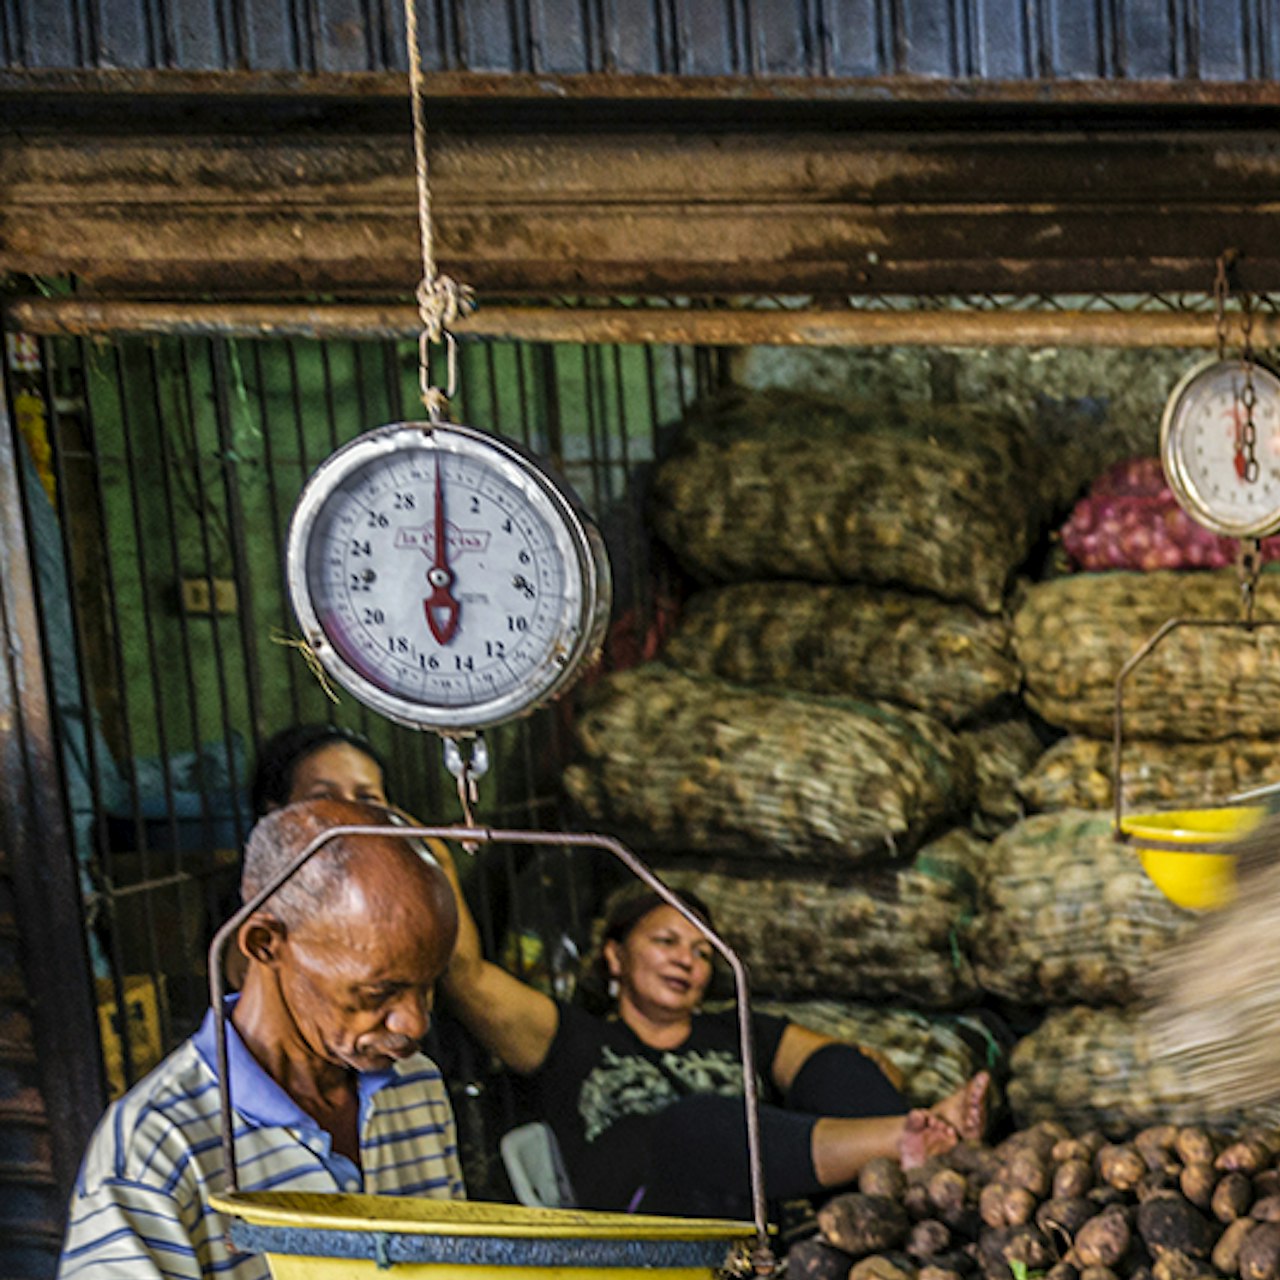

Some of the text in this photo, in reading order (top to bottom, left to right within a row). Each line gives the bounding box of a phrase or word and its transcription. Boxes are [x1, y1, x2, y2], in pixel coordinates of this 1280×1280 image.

[394, 491, 416, 510] 28
[471, 496, 479, 513] 2
[367, 509, 389, 528] 26
[501, 519, 512, 534] 4
[351, 540, 371, 556] 24
[518, 551, 530, 565] 6
[364, 607, 384, 625] 20
[507, 616, 526, 632] 10
[388, 637, 408, 653] 18
[486, 641, 505, 658] 12
[420, 653, 439, 670] 16
[455, 655, 474, 672] 14
